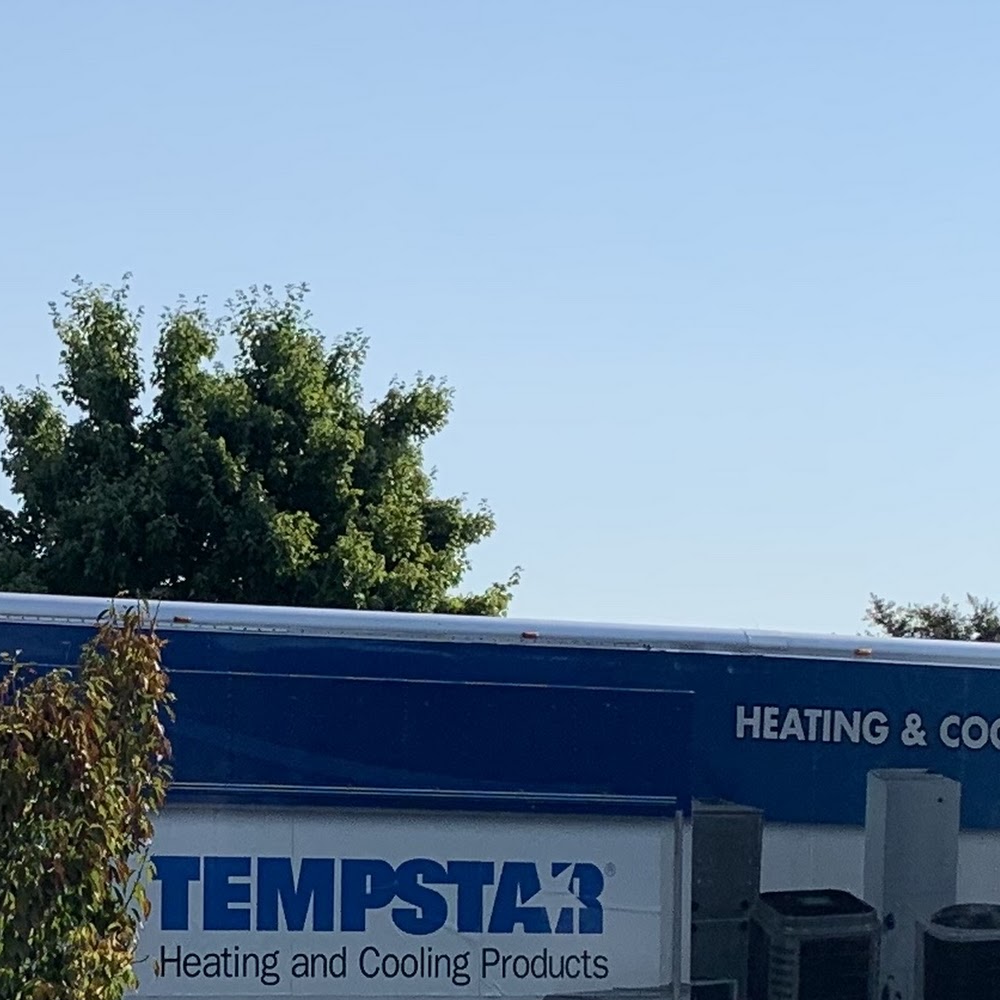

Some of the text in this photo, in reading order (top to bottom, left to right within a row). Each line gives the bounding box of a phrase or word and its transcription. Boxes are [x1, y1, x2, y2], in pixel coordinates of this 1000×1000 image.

[736, 705, 889, 745] HEATING
[901, 713, 927, 746] &
[160, 945, 609, 986] Heating and Cooling Products
